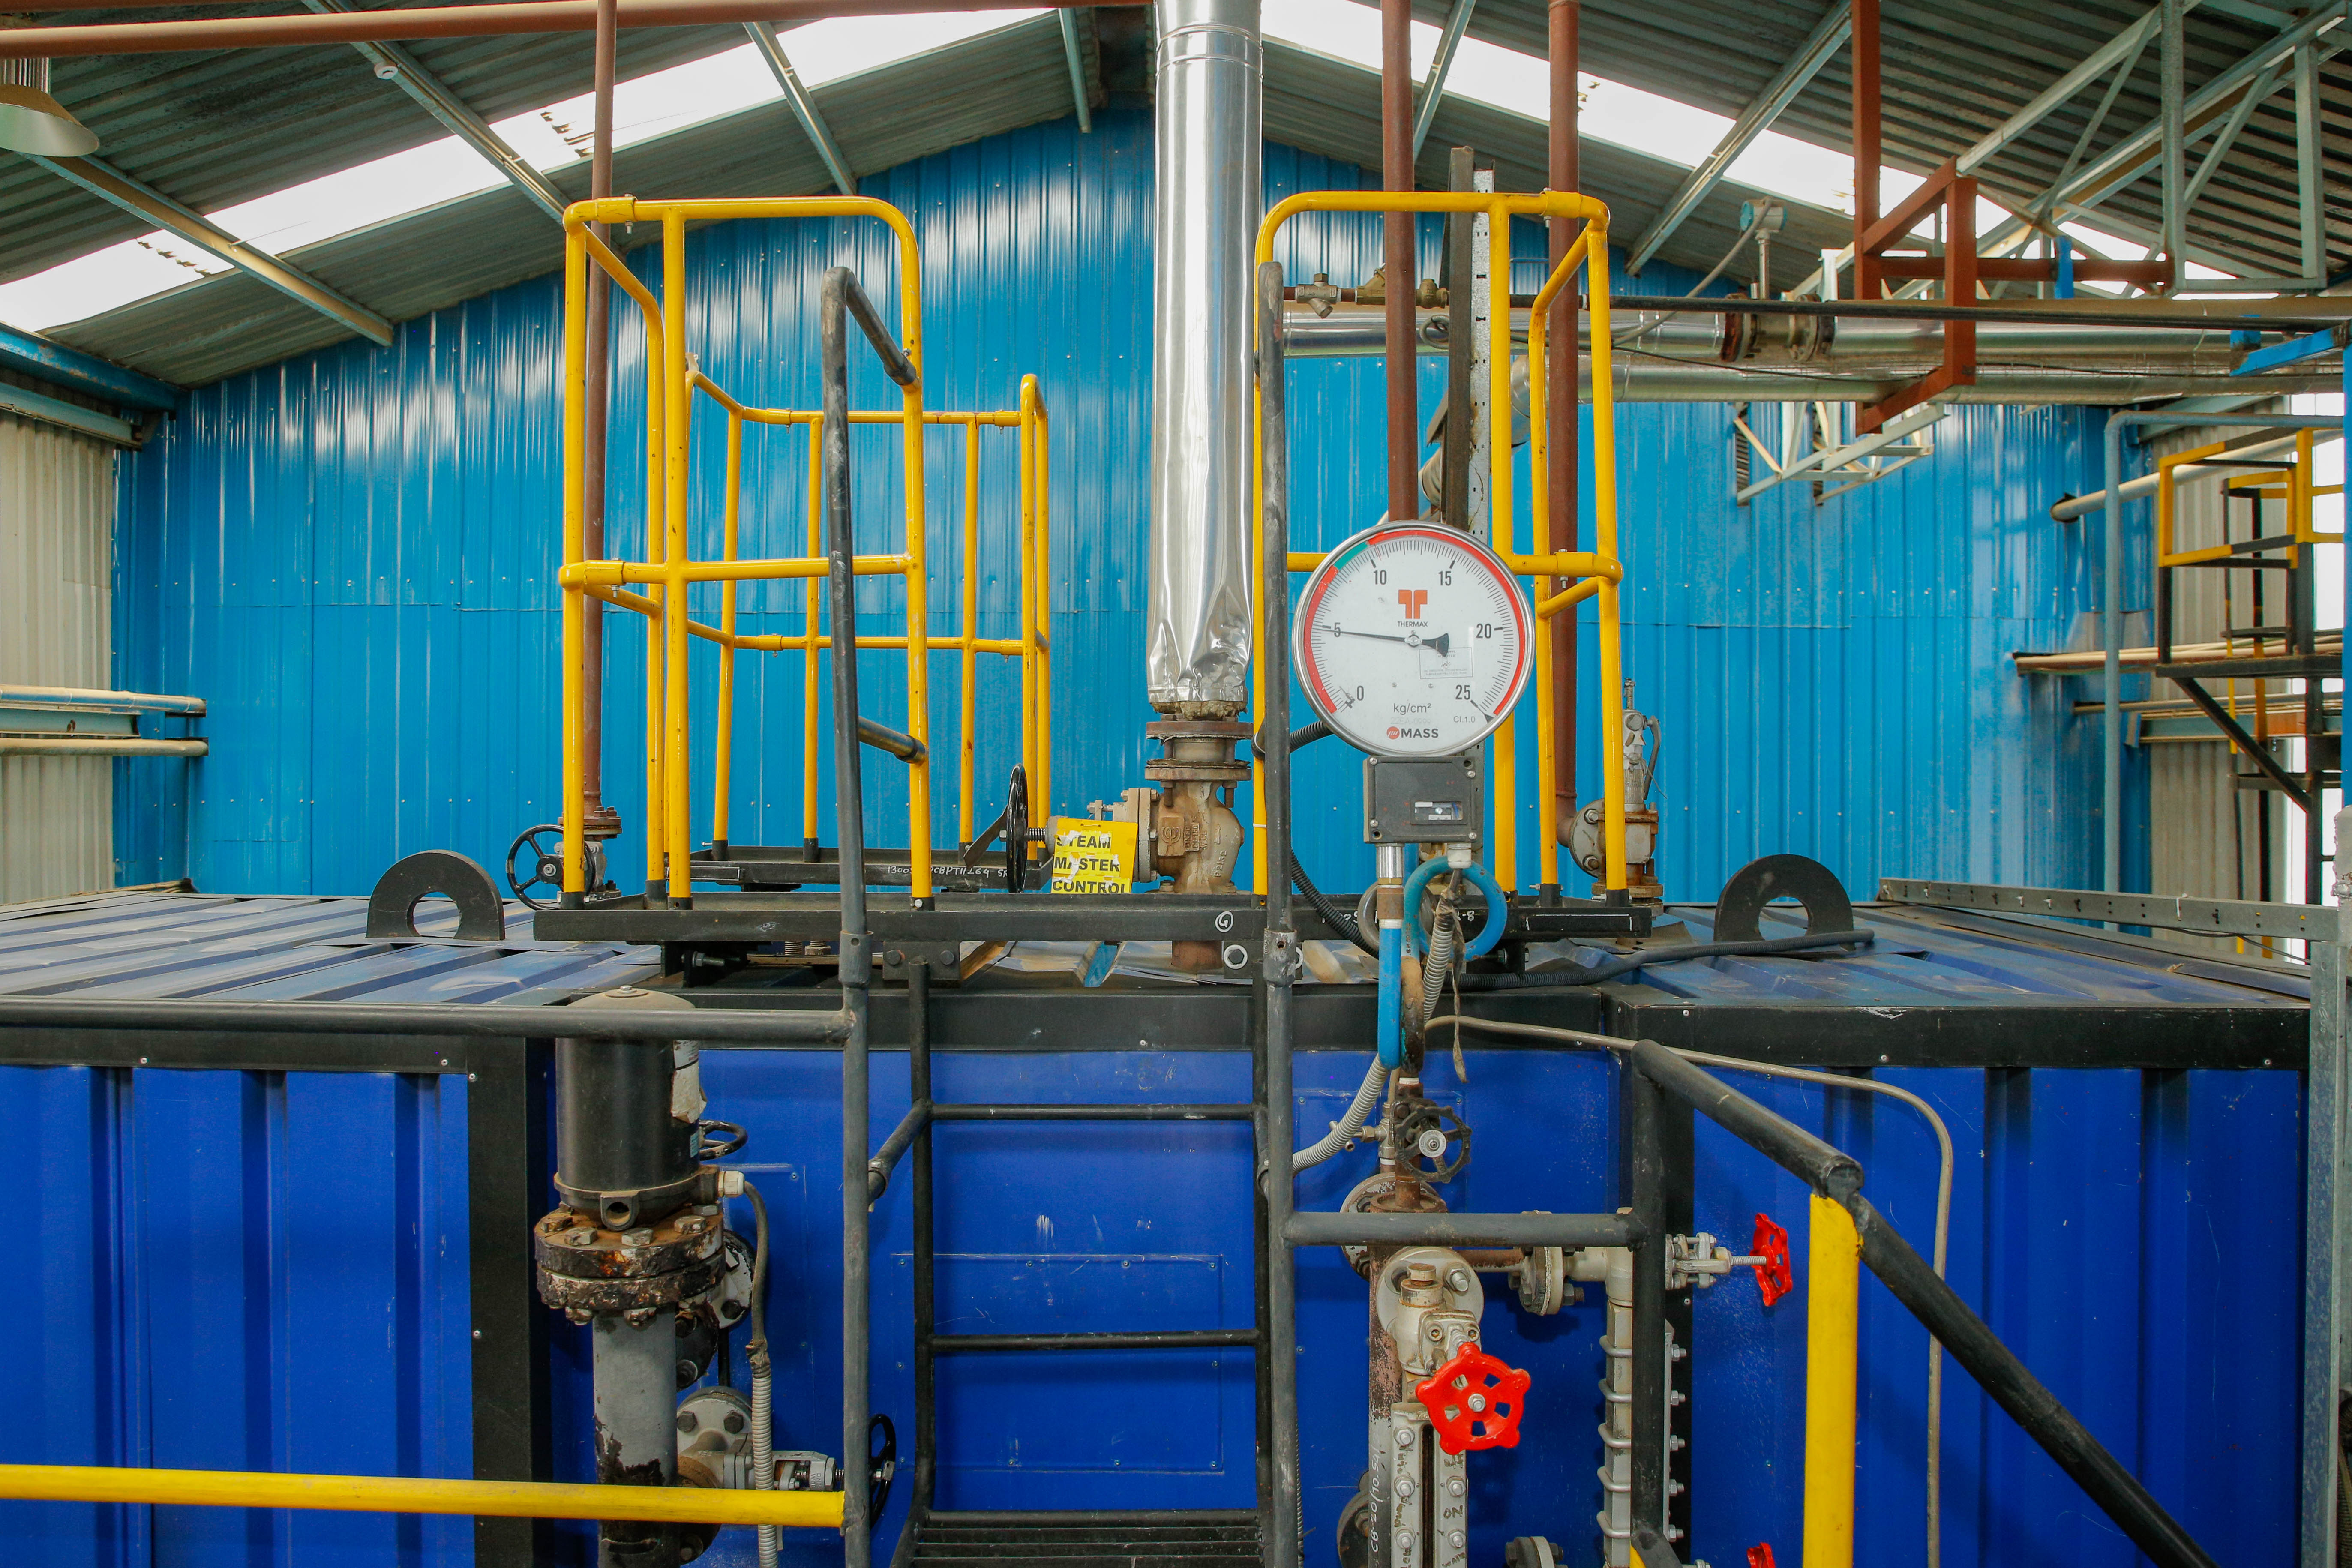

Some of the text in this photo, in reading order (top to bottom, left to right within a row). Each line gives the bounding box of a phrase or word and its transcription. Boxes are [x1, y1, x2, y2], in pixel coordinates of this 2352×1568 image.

[1374, 570, 1387, 585] 10
[1439, 571, 1452, 586] 15
[1334, 623, 1341, 637] 5
[1476, 624, 1492, 639] 20
[1356, 686, 1365, 701] 0
[1455, 685, 1471, 700] 25
[1401, 729, 1439, 739] MASS
[888, 865, 912, 874] 1300
[1054, 857, 1120, 872] MSTER
[1053, 880, 1129, 894] CONTROL
[1443, 1505, 1463, 1519] ON
